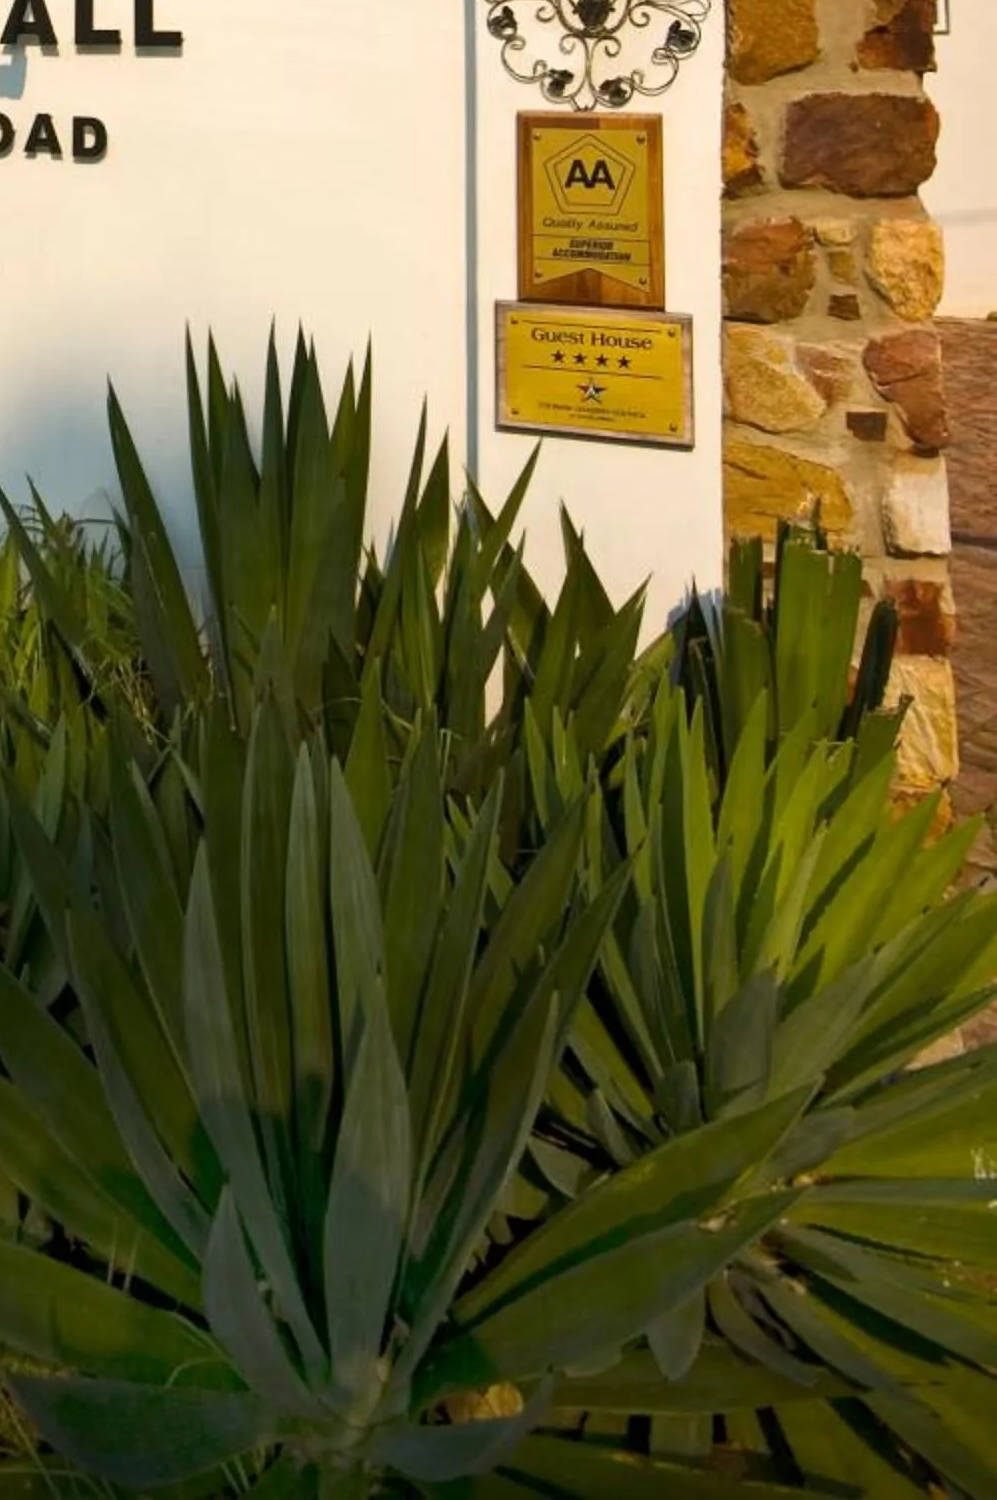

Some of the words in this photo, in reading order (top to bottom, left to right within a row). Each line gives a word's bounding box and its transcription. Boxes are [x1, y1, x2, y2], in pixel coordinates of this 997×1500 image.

[564, 159, 616, 190] AA
[542, 217, 583, 231] Quality
[588, 219, 638, 232] Assured
[531, 327, 585, 345] Guest
[590, 331, 653, 350] House
